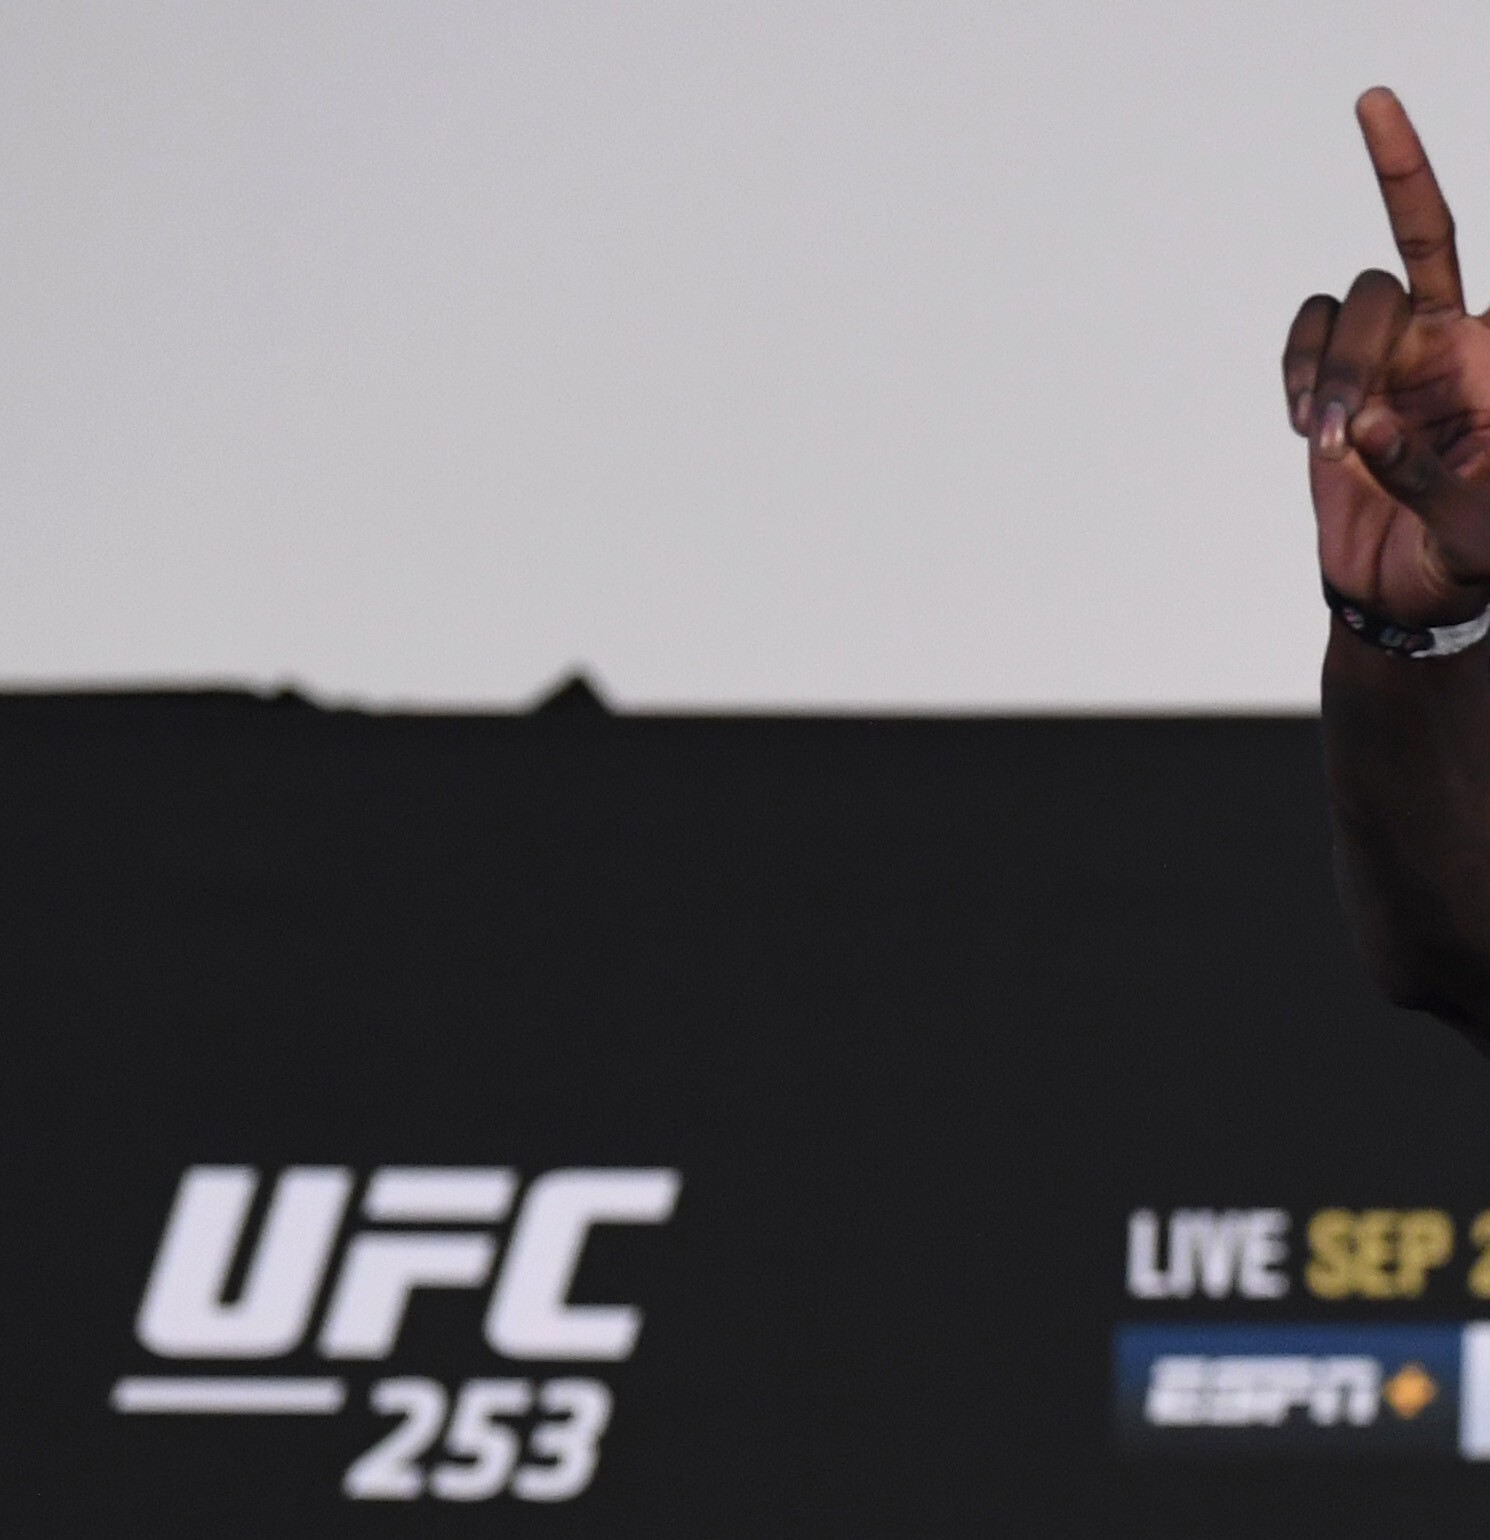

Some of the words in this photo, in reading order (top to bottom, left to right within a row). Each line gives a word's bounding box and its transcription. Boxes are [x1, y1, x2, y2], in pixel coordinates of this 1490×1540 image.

[136, 1166, 680, 1360] UFC
[1127, 1209, 1288, 1299] LIVE
[1305, 1208, 1454, 1300] SEP
[343, 1377, 612, 1502] 253
